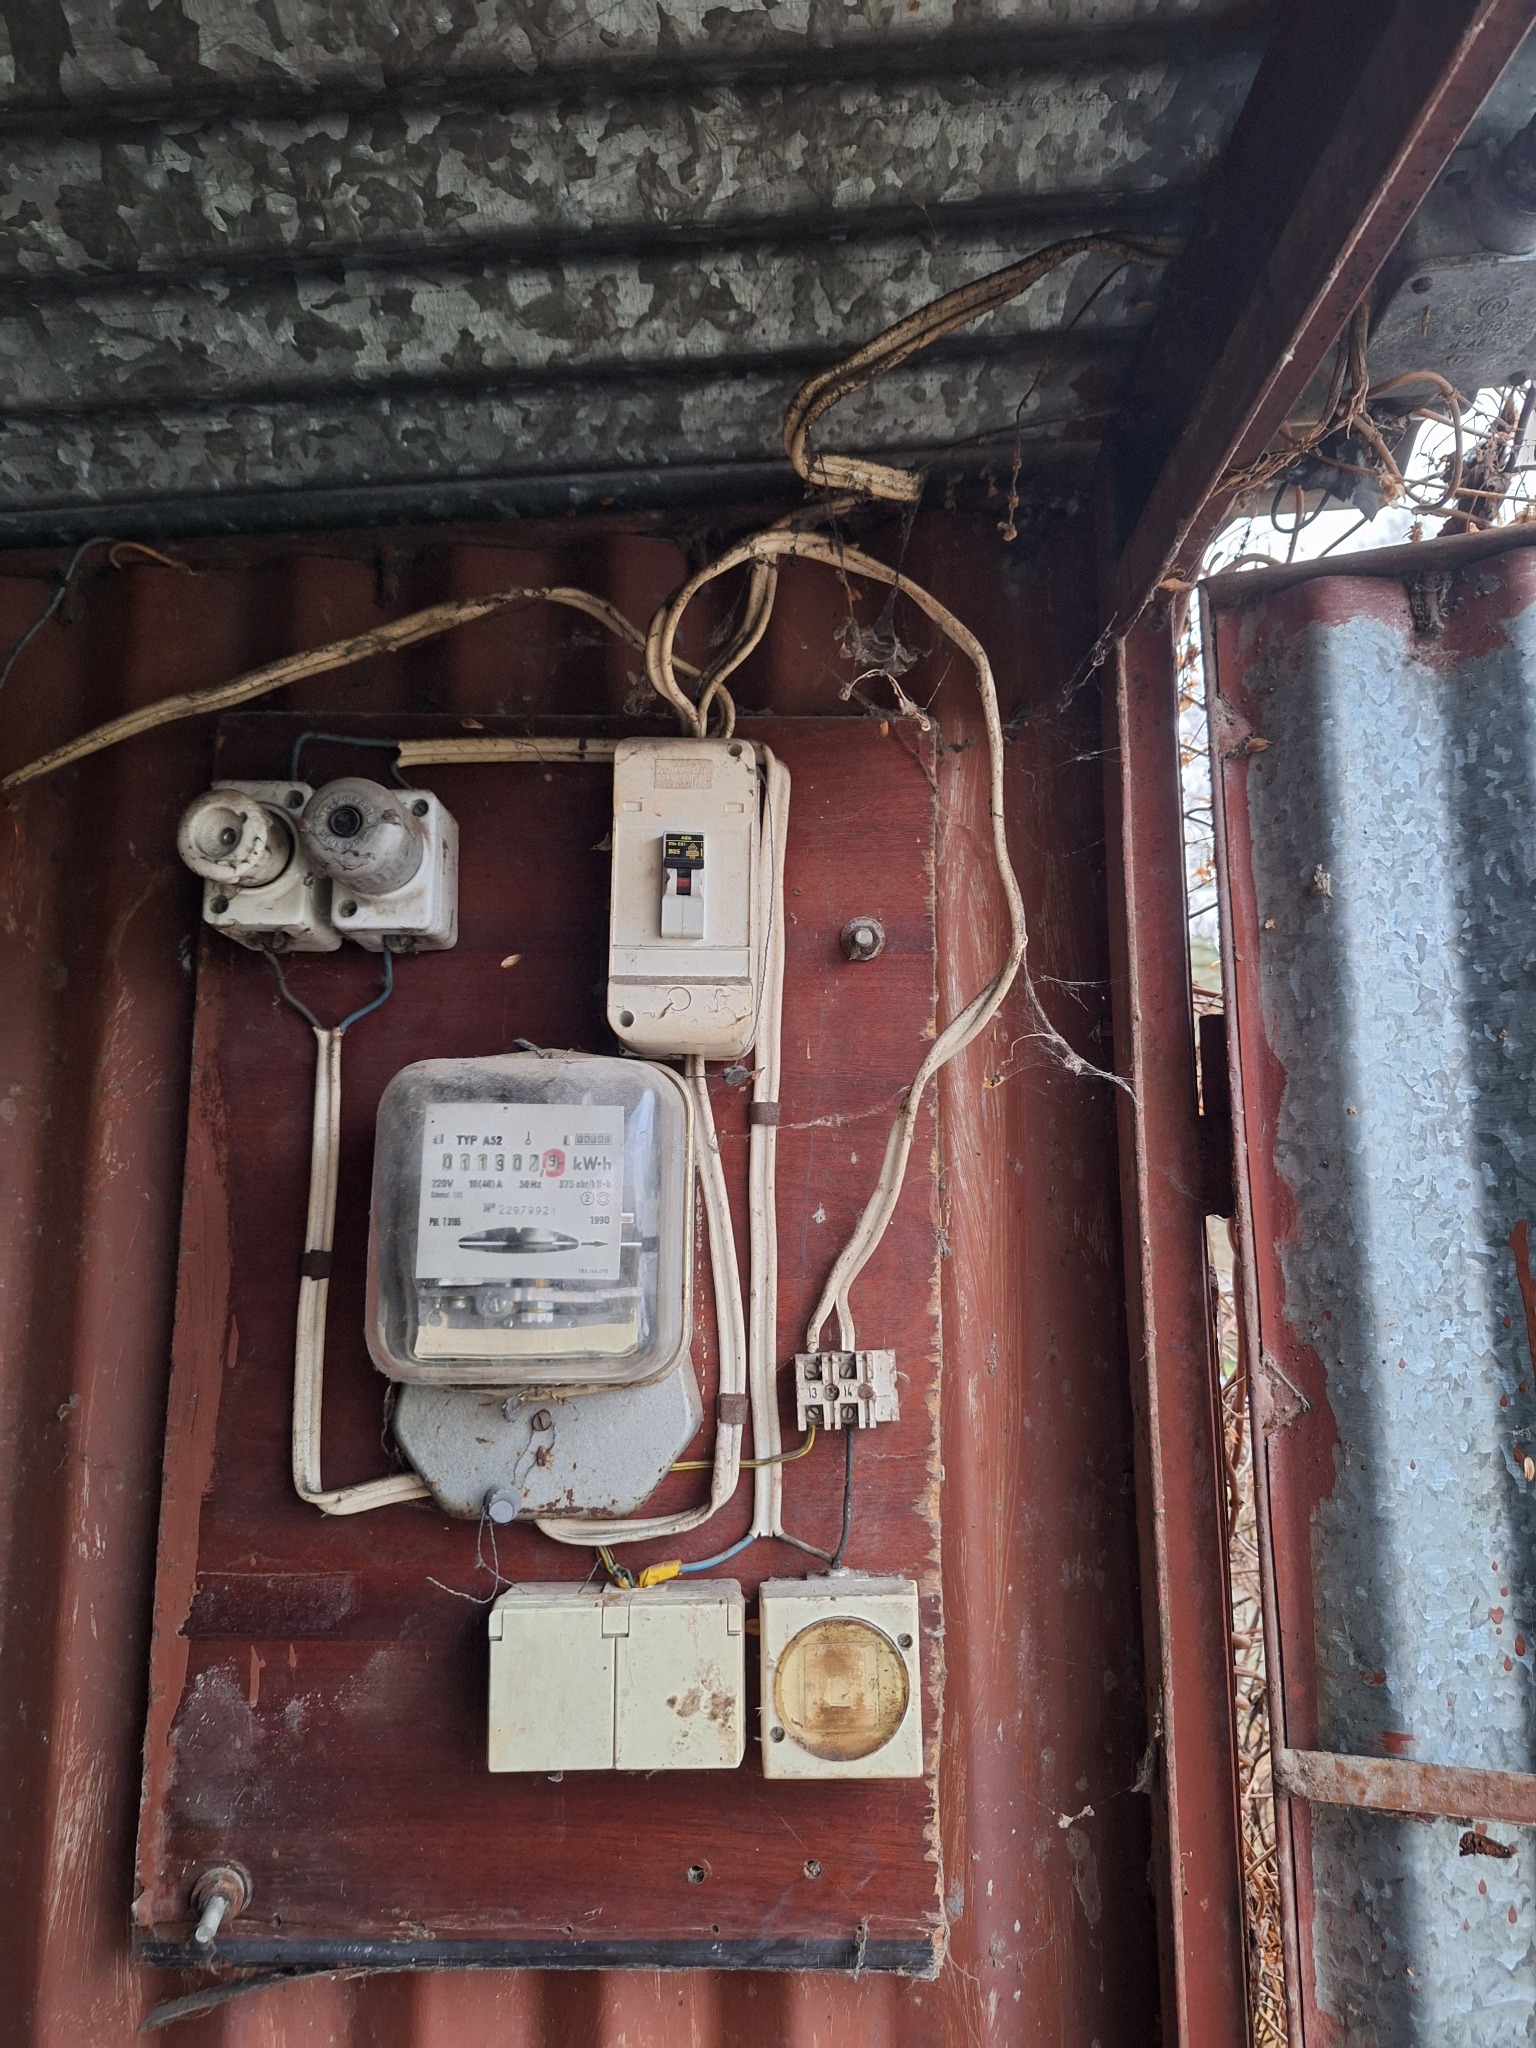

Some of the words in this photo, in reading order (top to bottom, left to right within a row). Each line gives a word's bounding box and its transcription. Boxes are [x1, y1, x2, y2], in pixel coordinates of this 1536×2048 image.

[456, 1135, 478, 1146] TYP
[482, 1135, 503, 1146] A52
[431, 1178, 454, 1188] 220V
[589, 1215, 610, 1225] 1990
[808, 1386, 817, 1399] 13
